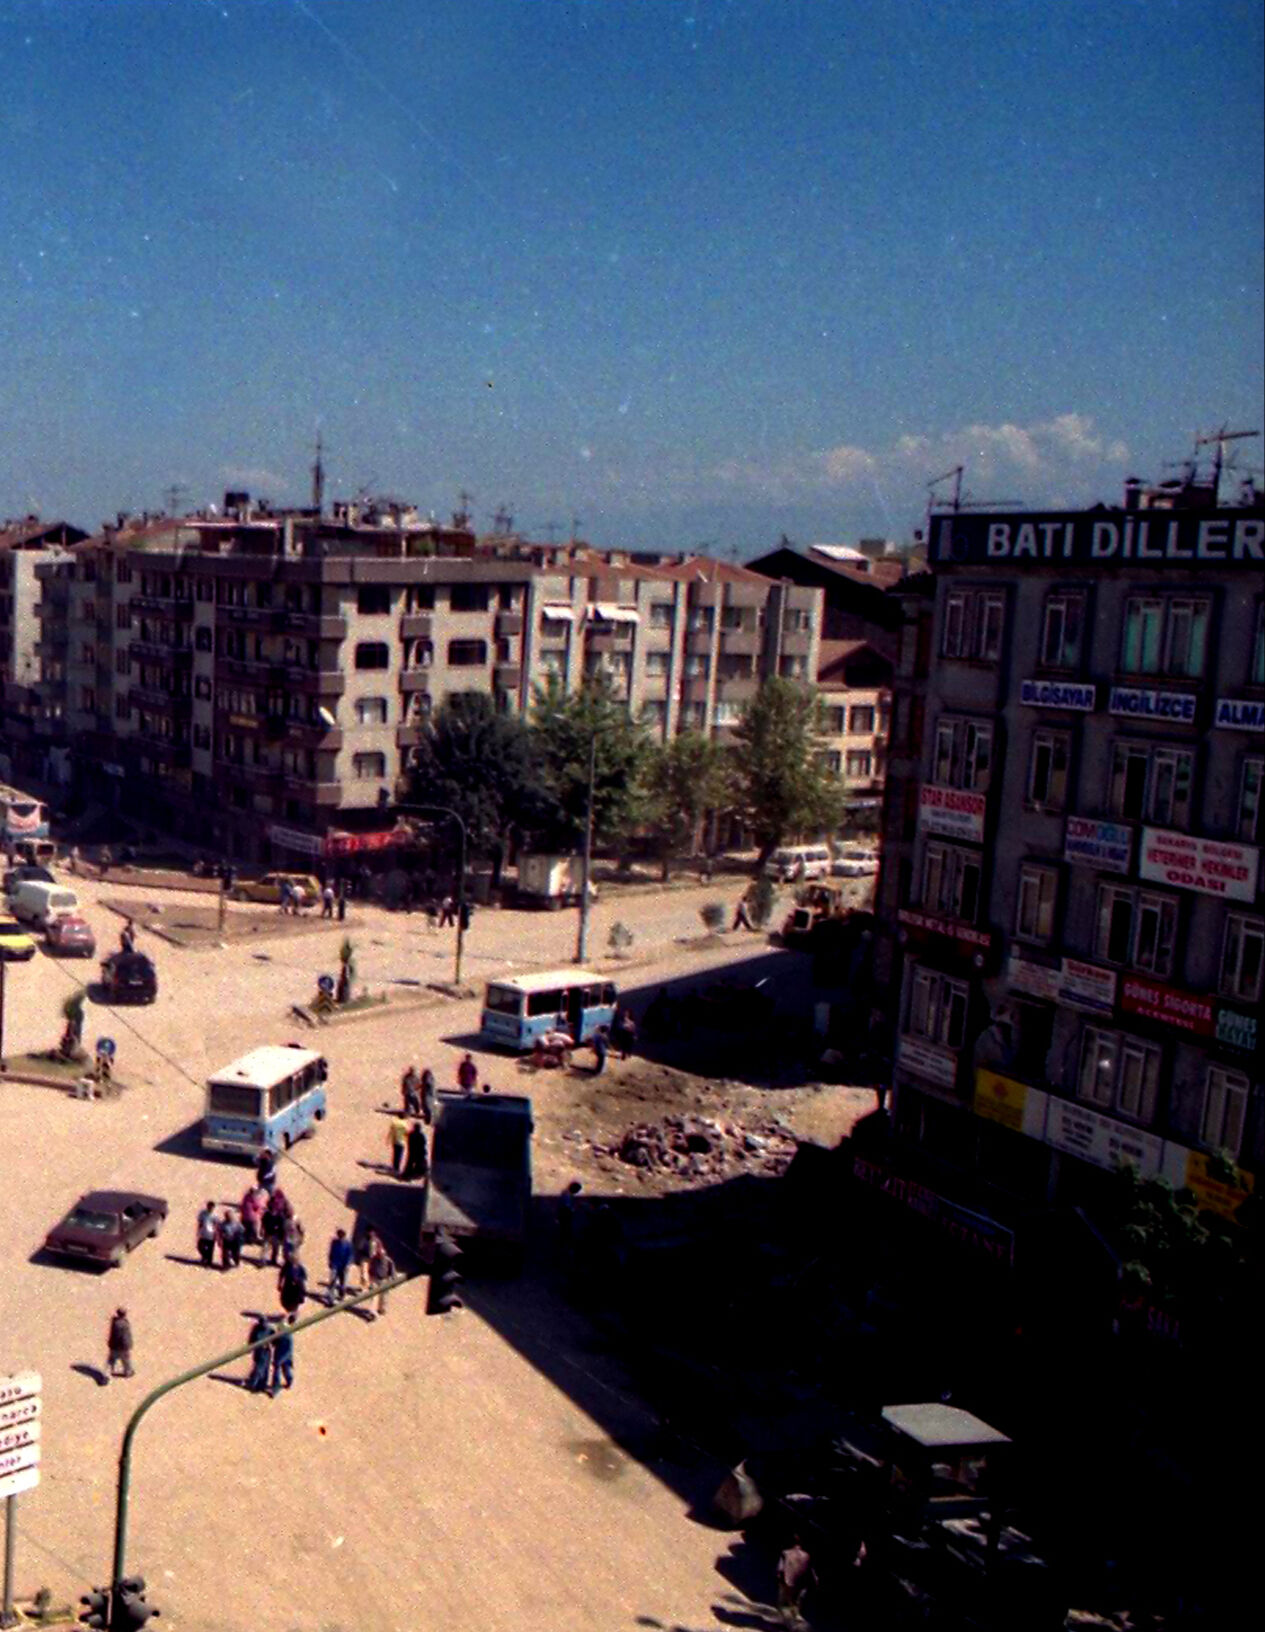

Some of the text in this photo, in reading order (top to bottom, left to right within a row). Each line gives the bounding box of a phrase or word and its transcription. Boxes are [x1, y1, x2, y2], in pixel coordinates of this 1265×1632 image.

[986, 521, 1075, 557] BATI
[1111, 689, 1195, 718] İNGİLİZCE
[1166, 871, 1226, 892] ODASI
